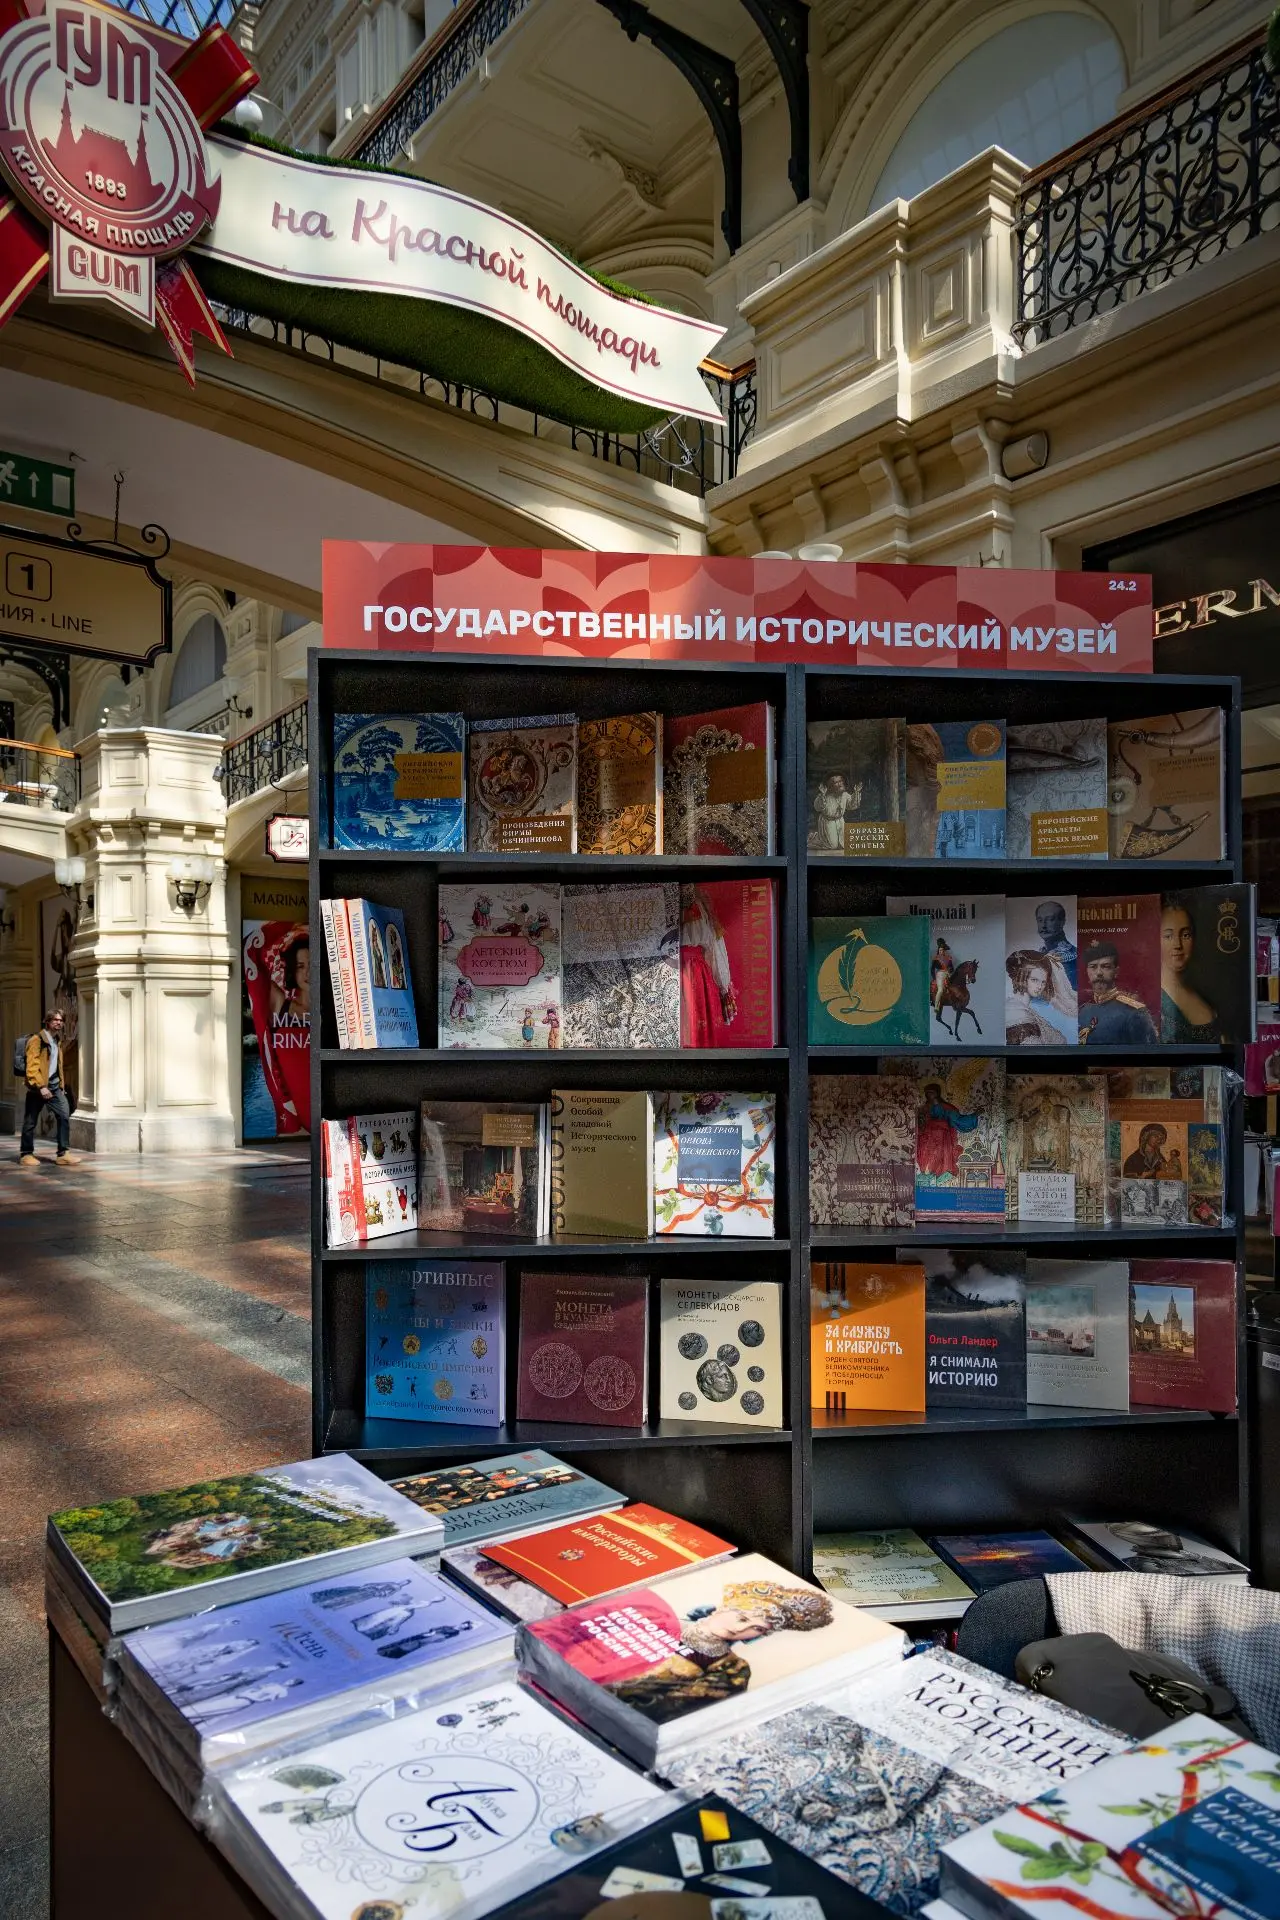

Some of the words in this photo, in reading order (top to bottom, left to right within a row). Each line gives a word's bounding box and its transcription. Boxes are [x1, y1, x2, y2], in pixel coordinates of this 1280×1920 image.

[56, 8, 150, 105] ГУМ
[85, 170, 127, 199] 1893
[12, 145, 100, 234] КРАСНАЯ
[106, 210, 195, 247] ПЛОЩАДЬ
[67, 245, 142, 296] GUM
[271, 201, 333, 240] на
[351, 198, 528, 291] Красной
[536, 276, 662, 375] площади
[20, 564, 34, 591] 1
[1108, 580, 1137, 592] 24.2
[52, 612, 93, 634] LINE
[363, 605, 726, 642] ГОСУДАРСТВЕННЫЙ
[736, 616, 1001, 650] ИСТОРИЧЕСКИЙ
[1010, 622, 1117, 655] МУЗЕЙ
[502, 820, 565, 830] ПРОИЗВЕДЕНИЯ
[1037, 815, 1099, 825] ЕВРОПЕЙСКИЕ
[849, 827, 886, 835] ОБРАЗЫ
[849, 834, 891, 842] РУССКИХ
[1037, 826, 1081, 835] АРБАЛЕТЫ
[502, 836, 563, 844] ОВЧИННИКОВА
[1071, 834, 1099, 843] ВЕКОВ
[253, 892, 308, 907] MARINA
[1077, 903, 1123, 921] иколай
[353, 911, 364, 938] МИРА
[324, 911, 338, 964] КОСТЮМЫ
[338, 911, 348, 959] КОСТЮМЫ
[471, 947, 527, 957] ДЕТСКИЙ
[355, 941, 369, 985] НАРОДОВ
[471, 959, 528, 968] КОСТЮМ
[329, 968, 347, 1037] ТЕАТРАЛЬНЫЕ
[341, 967, 357, 1034] МАСКАРАДНЫЕ
[359, 988, 373, 1036] КОСТЮМЫ
[570, 1095, 621, 1105] Сокровища
[570, 1107, 603, 1116] Особой
[570, 1118, 613, 1129] кладовой
[714, 1126, 739, 1135] ГРАФА
[570, 1131, 637, 1142] Исторического
[570, 1145, 597, 1154] музея
[680, 1147, 740, 1156] ЧЕСМЕНСКОГО
[1025, 1174, 1067, 1183] БИБЛИЯ
[1026, 1191, 1067, 1200] КАНОН
[677, 1290, 720, 1300] МОНЕТЫ
[554, 1301, 613, 1313] МОНЕТА
[677, 1302, 740, 1312] СЕЛЕВКИДОВ
[825, 1324, 839, 1338] ЗА
[842, 1325, 890, 1339] СЛУЖБУ
[825, 1340, 833, 1353] И
[836, 1341, 903, 1355] ХРАБРОСТЬ
[929, 1334, 958, 1346] Ольга
[961, 1335, 998, 1348] Ландер
[825, 1364, 890, 1372] ВЕЛИКОМУЧЕНИКА
[929, 1356, 937, 1366] Я
[941, 1355, 998, 1369] СНИМАЛА
[832, 1372, 884, 1380] ПОБЕДОНОСЦА
[929, 1371, 998, 1387] ИСТОРИЮ
[442, 1499, 529, 1524] НАСТИЯ
[444, 1502, 552, 1533] ОМАНОВЫХ
[571, 1528, 647, 1567] императоры
[586, 1523, 658, 1561] Российские
[594, 1615, 666, 1663] ГУБЕРНИЙ
[607, 1609, 678, 1659] КОСТЮМЫ
[620, 1606, 695, 1657] НАРОДНЫЕ
[579, 1620, 635, 1660] РОССИИ
[924, 1671, 1113, 1767] РУССКИЙ
[902, 1686, 1085, 1779] МОДНИК
